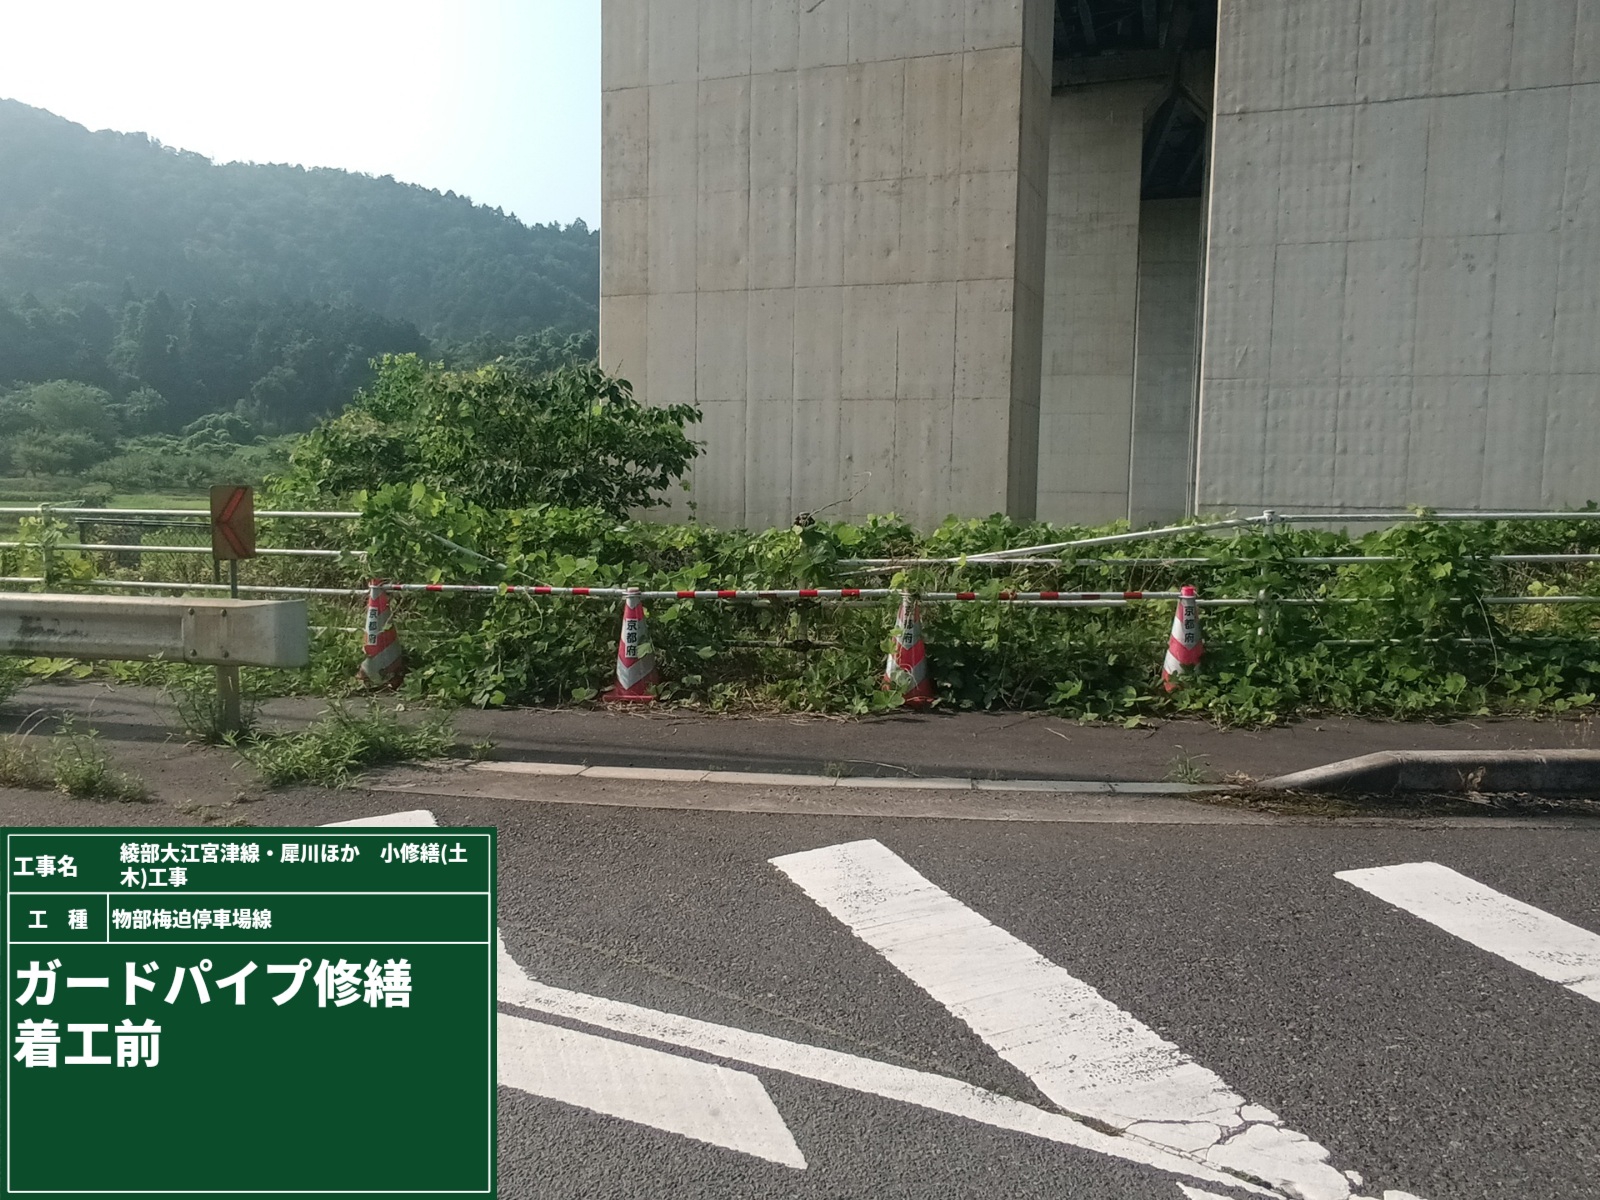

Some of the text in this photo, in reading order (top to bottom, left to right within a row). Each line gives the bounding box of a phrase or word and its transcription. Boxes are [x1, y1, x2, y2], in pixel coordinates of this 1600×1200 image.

[368, 608, 377, 644] 京都府
[626, 620, 637, 656] 京都府
[1184, 606, 1195, 643] 京都府
